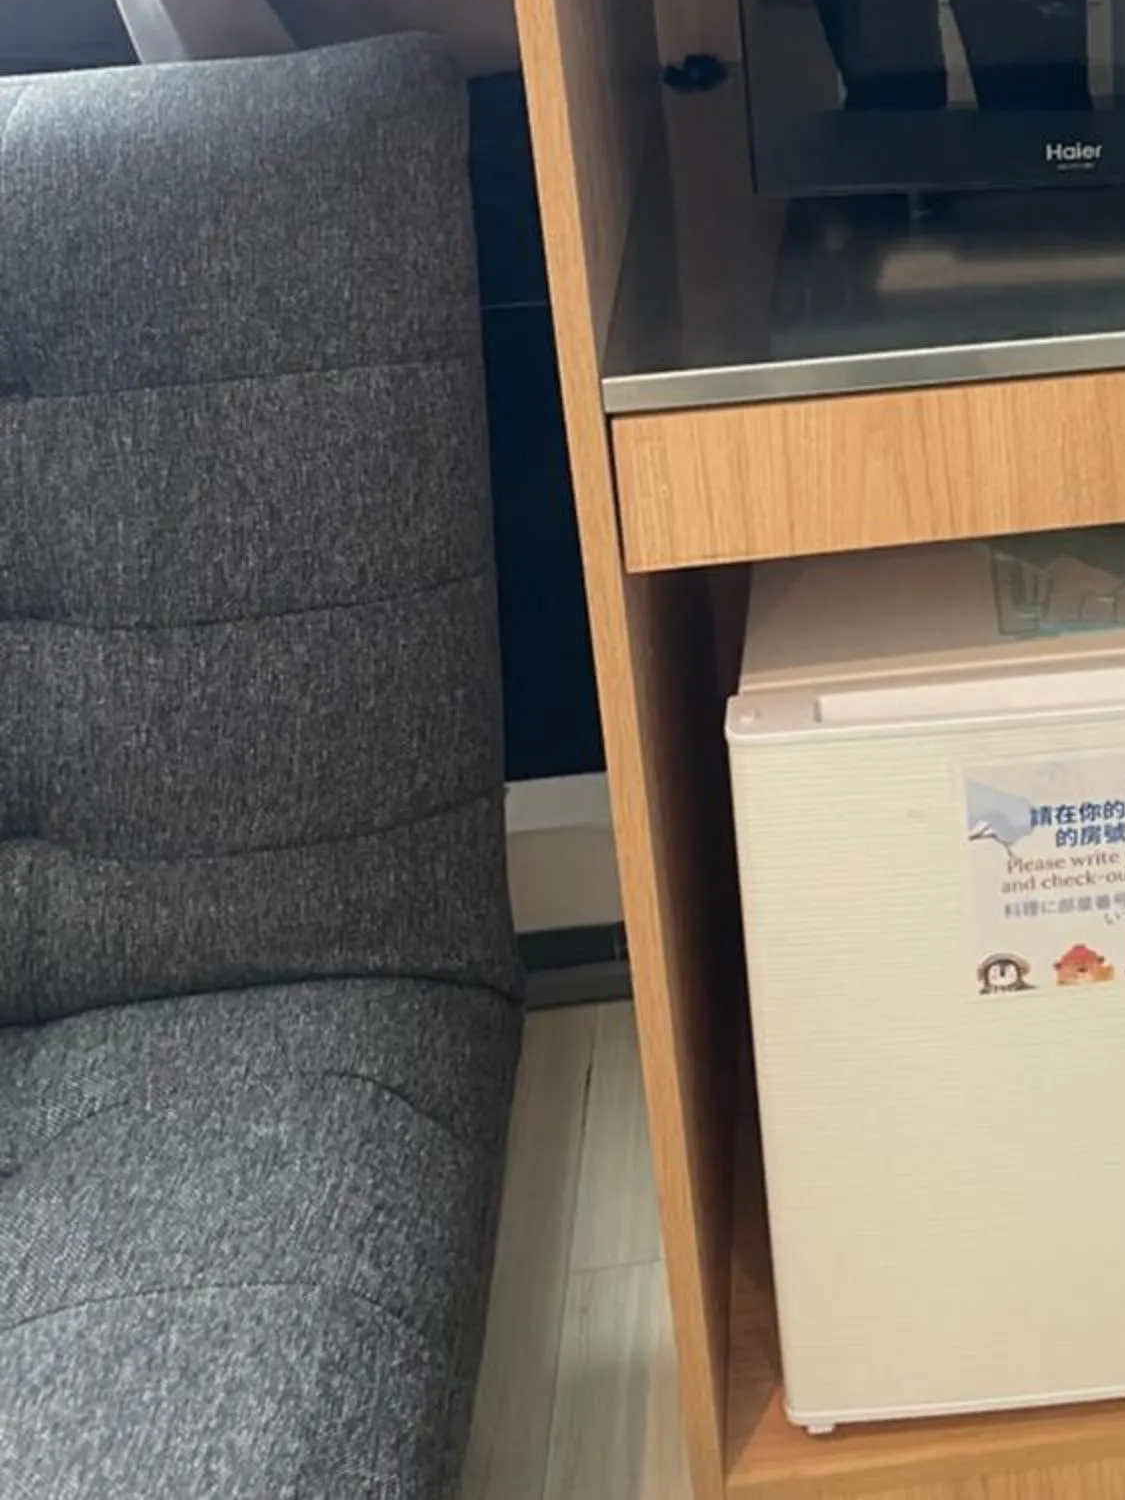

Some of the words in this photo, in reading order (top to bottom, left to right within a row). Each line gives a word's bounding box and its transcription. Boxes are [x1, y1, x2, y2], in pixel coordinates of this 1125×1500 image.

[1045, 141, 1103, 161] Haier
[1006, 855, 1066, 875] Please
[1070, 850, 1119, 869] write
[1001, 874, 1035, 894] and
